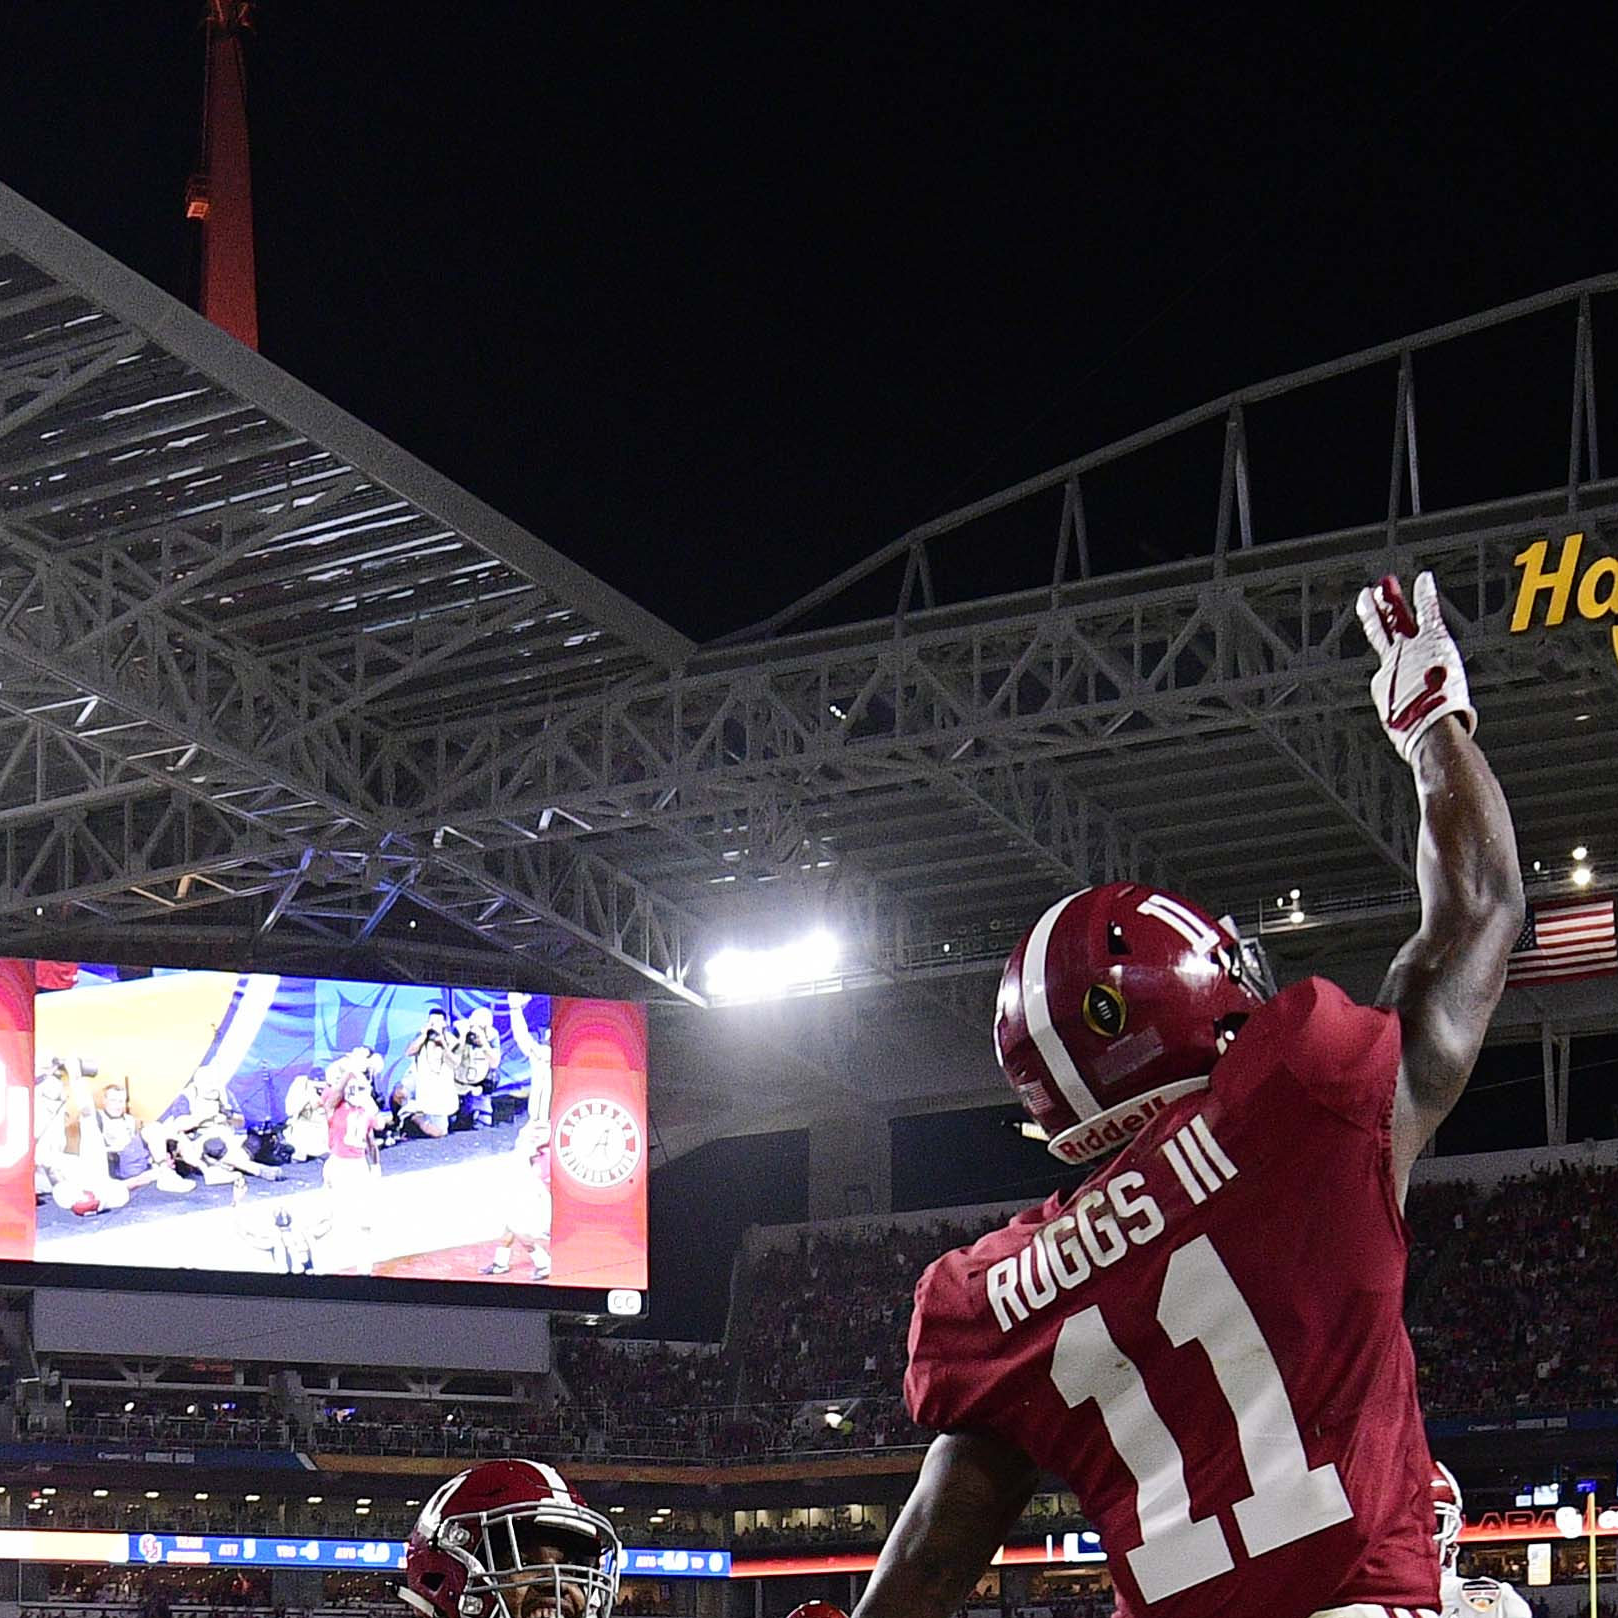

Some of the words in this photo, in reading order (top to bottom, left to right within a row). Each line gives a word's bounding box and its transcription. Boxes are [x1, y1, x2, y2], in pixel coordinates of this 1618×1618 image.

[986, 1171, 1166, 1333] RUGGS
[1160, 1113, 1239, 1205] III
[1050, 1233, 1354, 1604] 11
